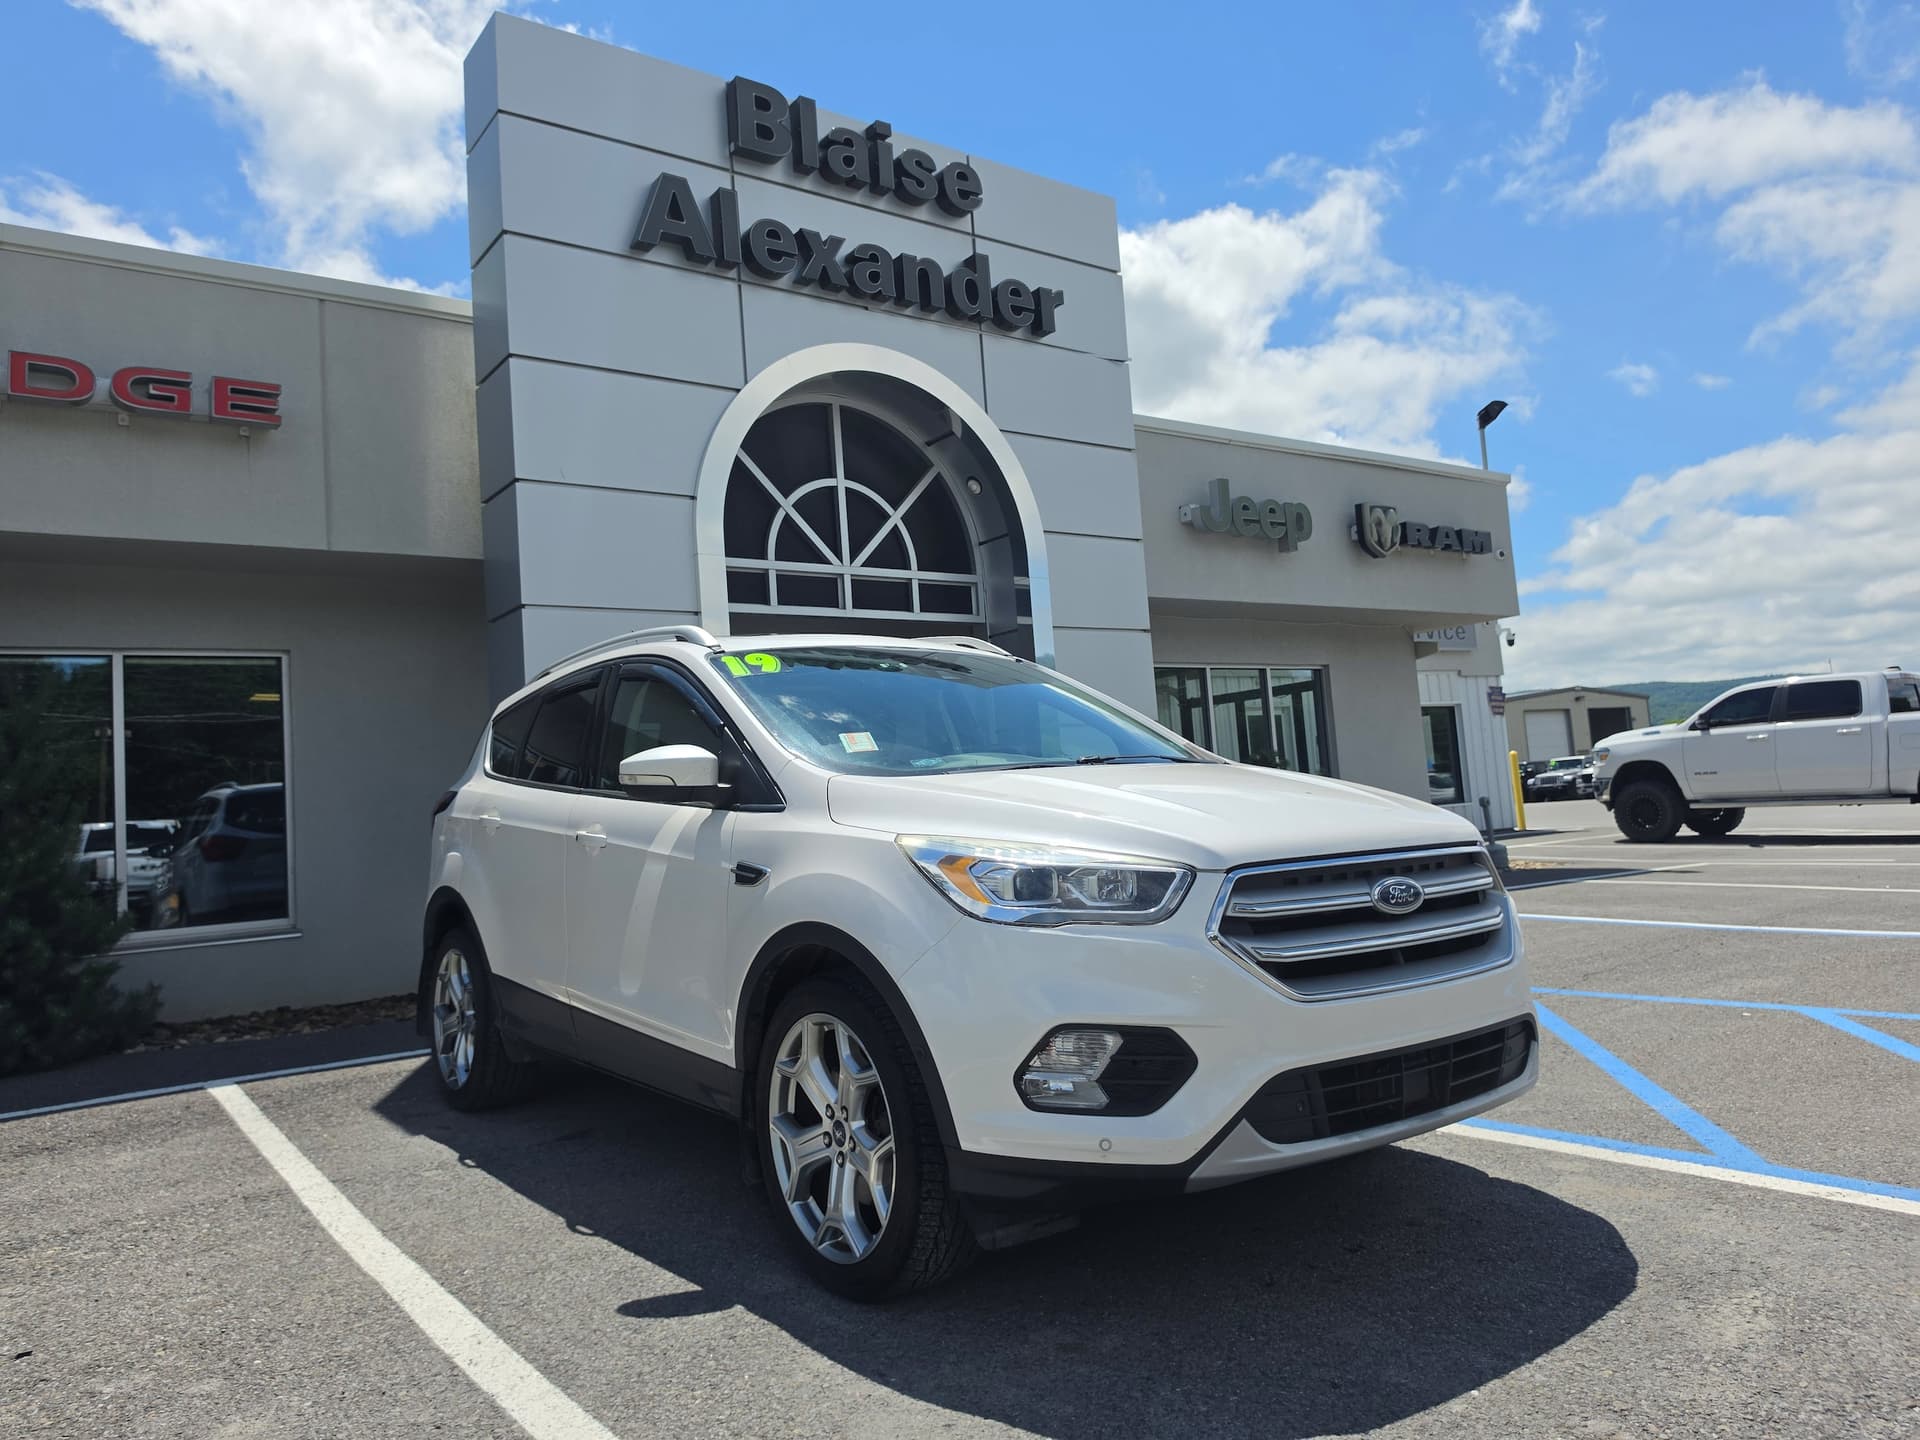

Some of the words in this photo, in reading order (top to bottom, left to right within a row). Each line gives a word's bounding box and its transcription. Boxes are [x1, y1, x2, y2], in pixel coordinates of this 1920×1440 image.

[726, 75, 984, 218] Blaise
[631, 171, 1064, 338] Alexander
[8, 350, 282, 430] DGE
[1196, 478, 1313, 552] Jeep
[1400, 521, 1493, 554] RAM
[720, 652, 783, 678] 19
[1389, 885, 1415, 904] Ford
